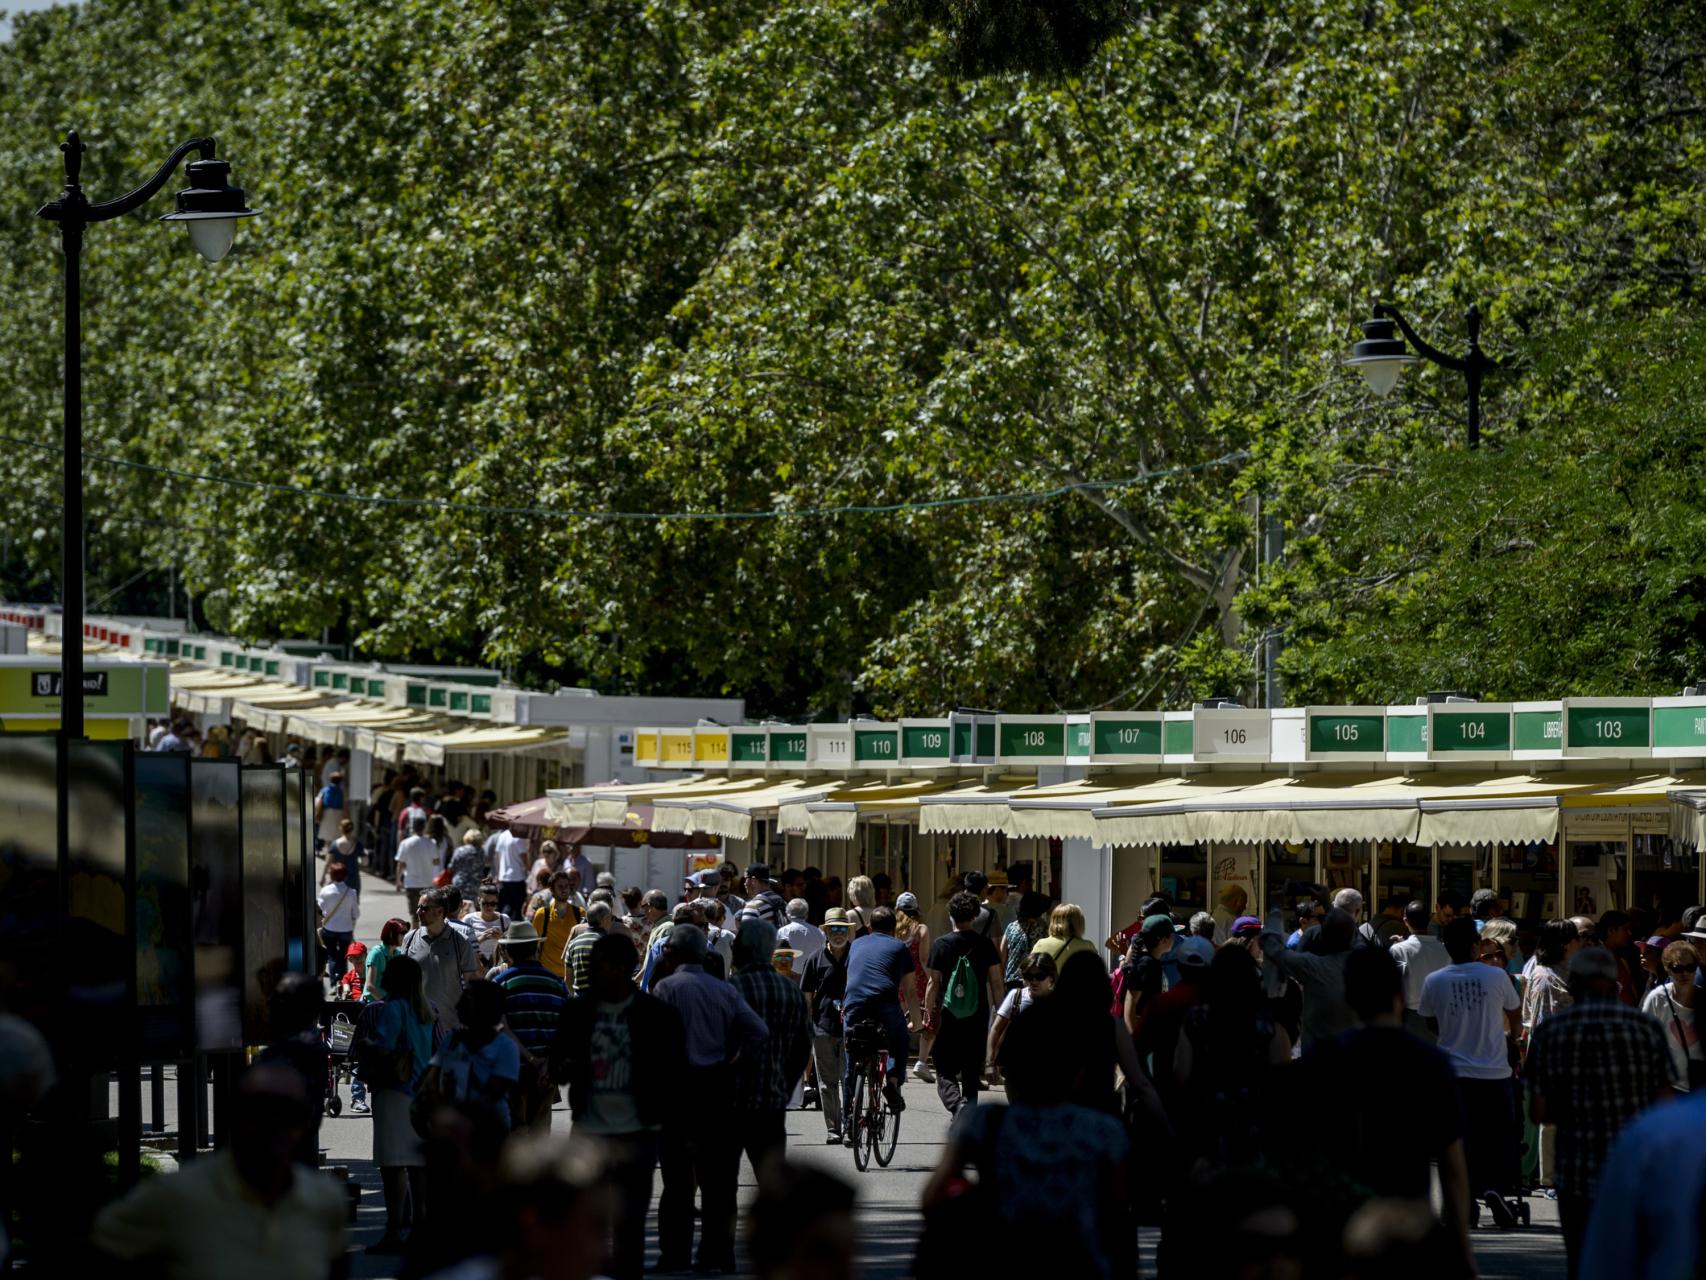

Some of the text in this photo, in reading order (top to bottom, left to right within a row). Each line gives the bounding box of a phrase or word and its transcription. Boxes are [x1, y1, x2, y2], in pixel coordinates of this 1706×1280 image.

[1117, 728, 1140, 744] 107
[1223, 729, 1246, 744] 106
[1333, 724, 1358, 741] 105
[1459, 722, 1485, 739] 104
[1596, 721, 1622, 738] 103
[922, 734, 942, 748] 109
[1023, 731, 1045, 746] 108
[711, 743, 727, 753] 114
[749, 740, 765, 753] 113
[787, 740, 805, 752] 112
[829, 741, 846, 753] 111
[872, 740, 891, 754] 110
